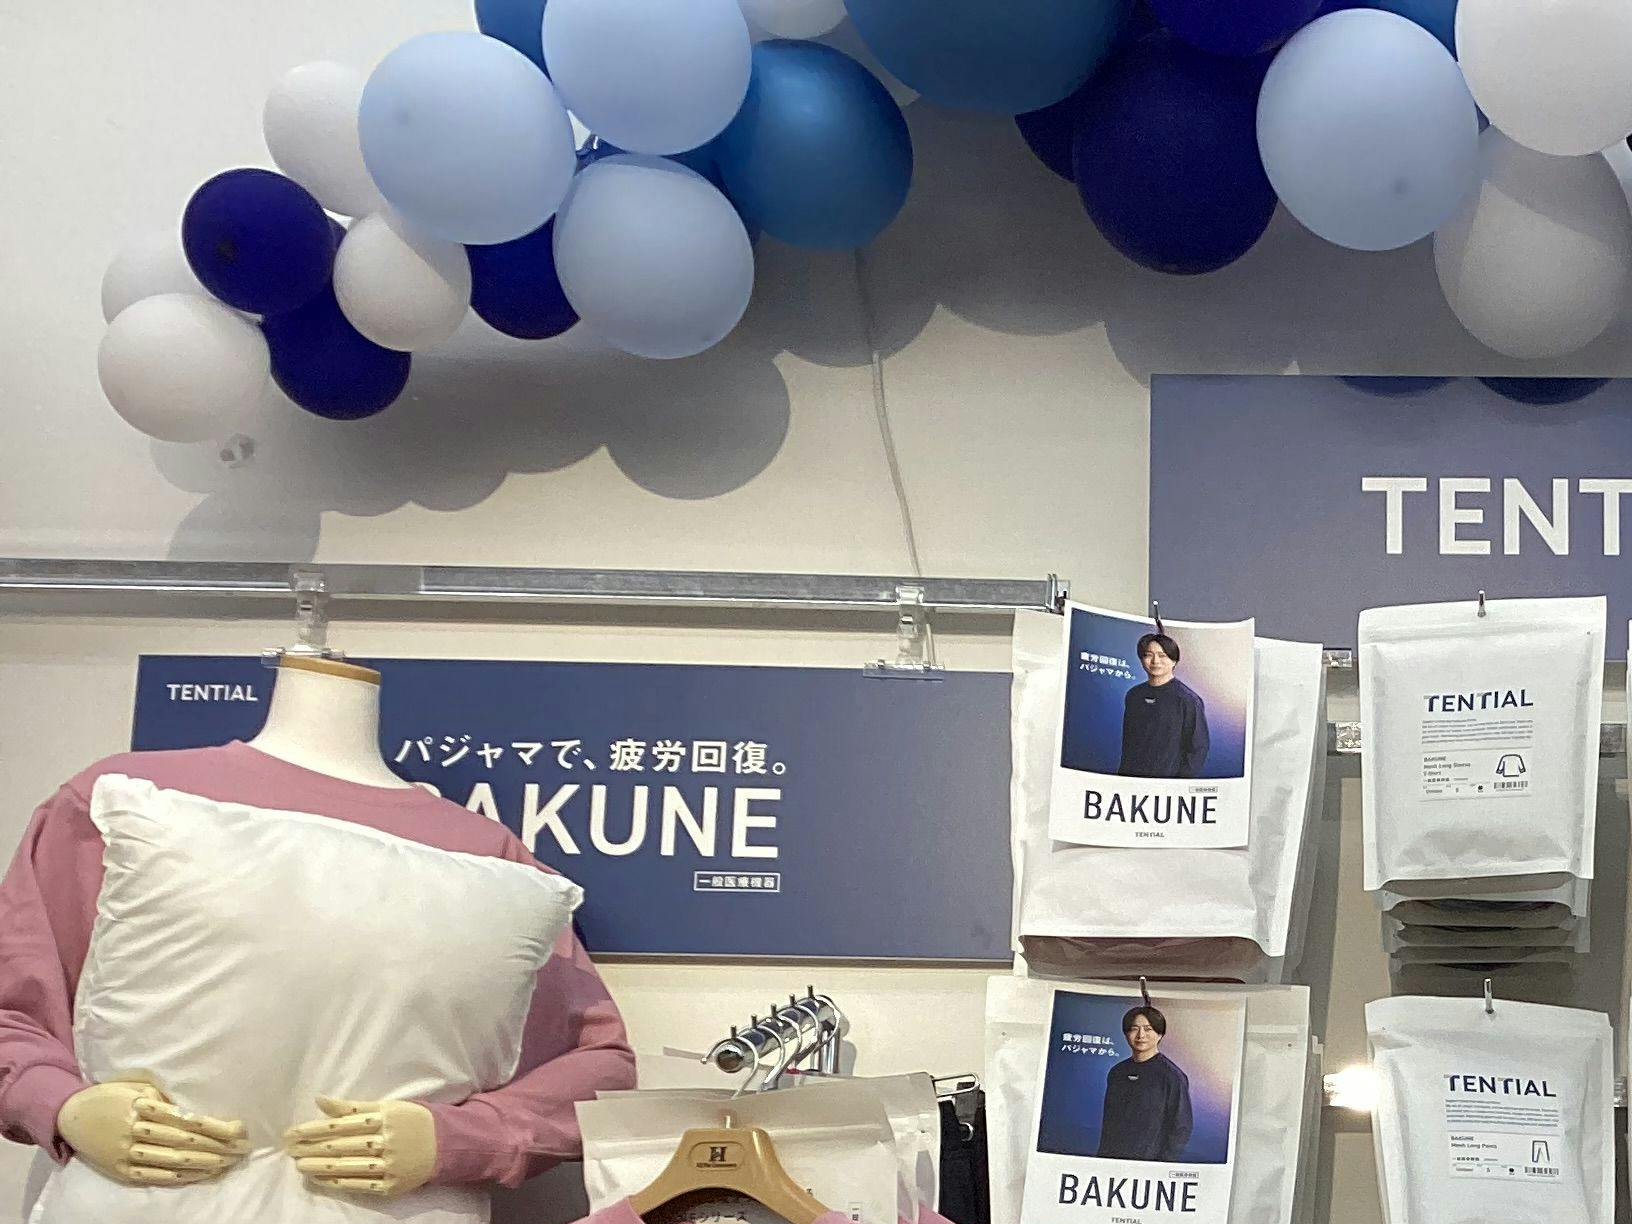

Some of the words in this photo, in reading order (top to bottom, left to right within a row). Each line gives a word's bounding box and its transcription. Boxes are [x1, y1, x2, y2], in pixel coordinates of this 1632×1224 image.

[166, 683, 259, 701] TENTIAL
[1423, 689, 1534, 713] TENTIAL
[394, 734, 787, 776] パジャマで、疲労回復。
[1083, 789, 1219, 825] BAKUNE
[1443, 1074, 1557, 1098] TENTIAL
[1058, 1172, 1200, 1213] BAKUNE
